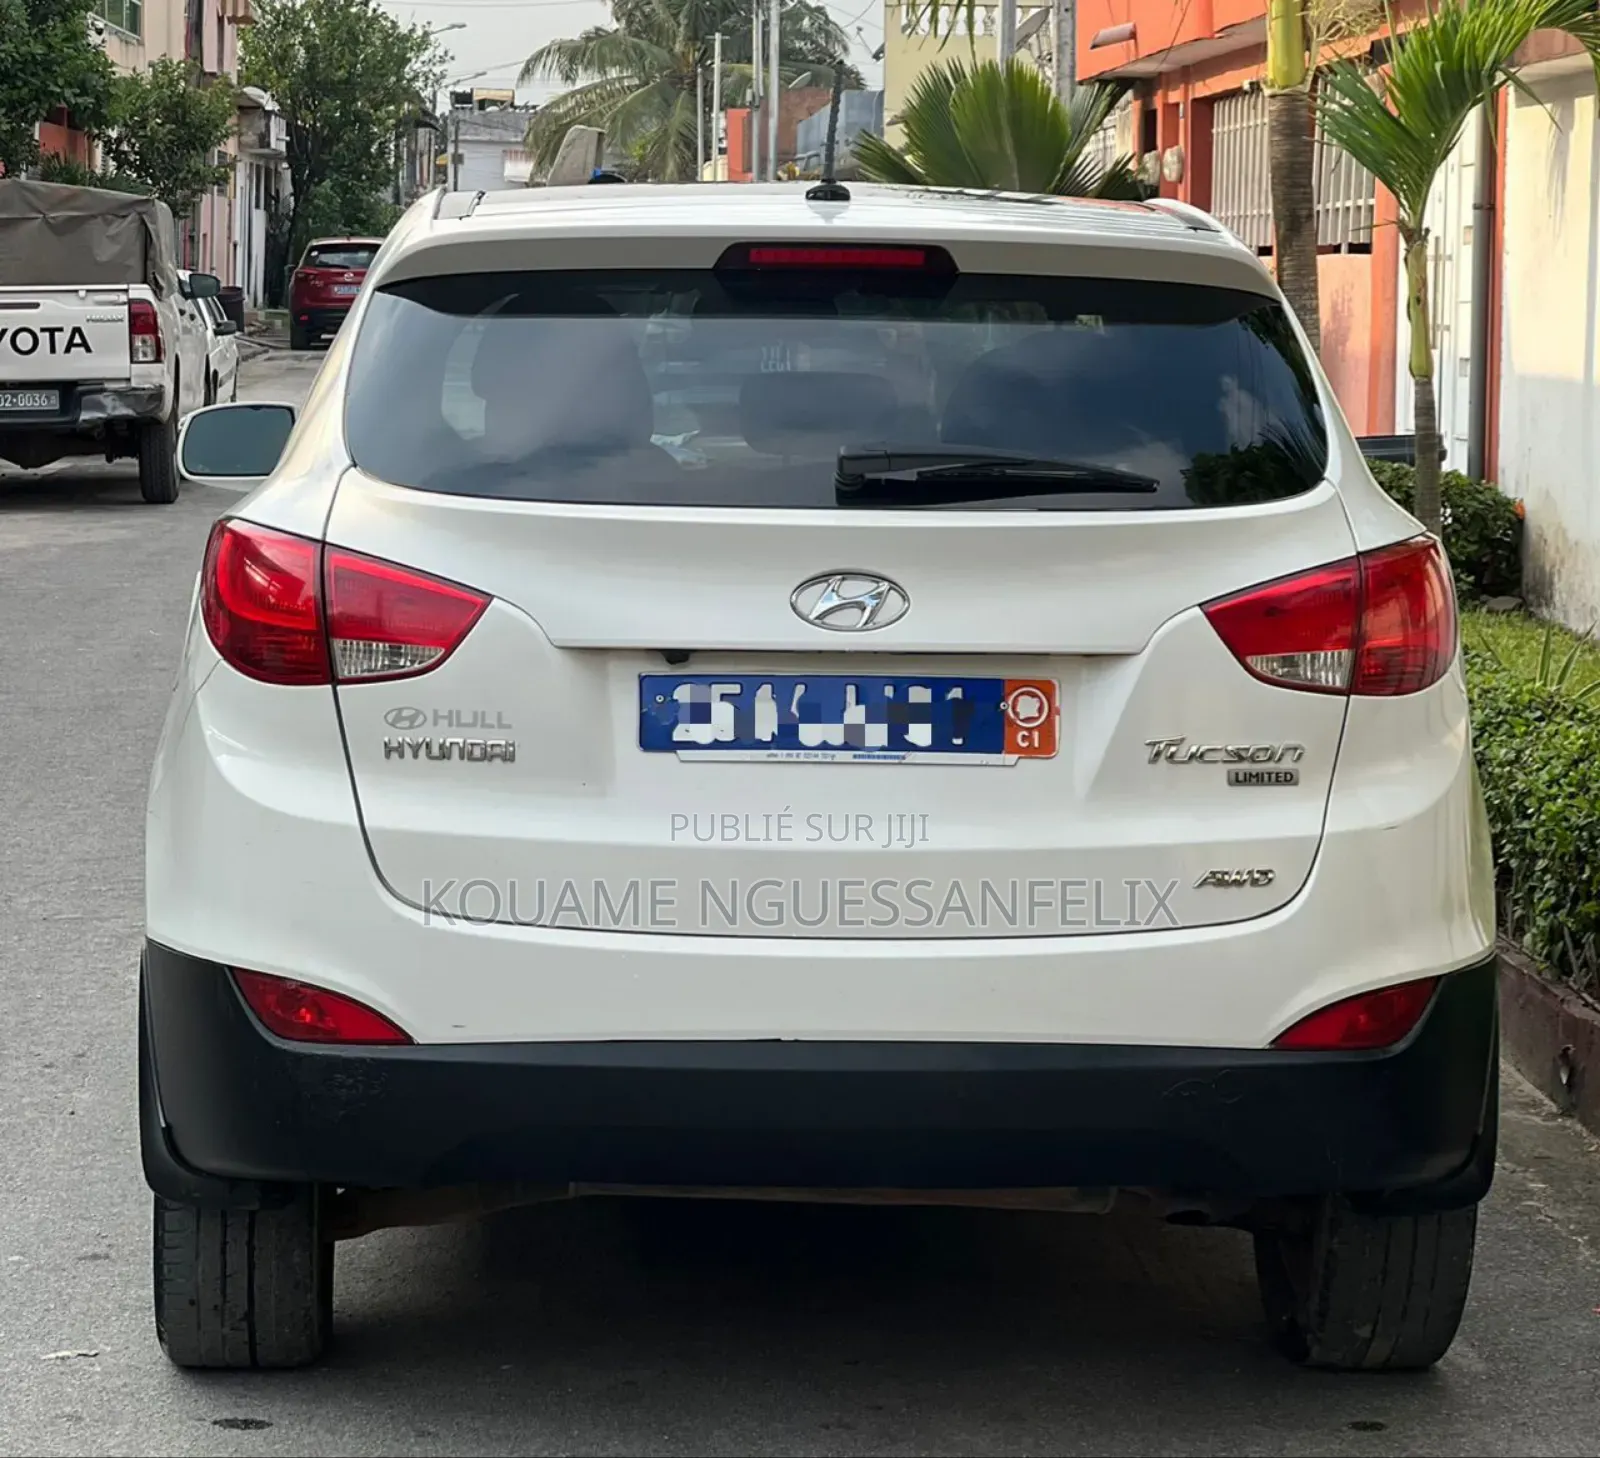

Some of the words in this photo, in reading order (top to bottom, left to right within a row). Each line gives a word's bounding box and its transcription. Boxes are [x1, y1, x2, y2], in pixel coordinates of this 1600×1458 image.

[432, 708, 513, 730] HULL
[383, 736, 516, 763] HYUNDAI
[1016, 731, 1040, 749] CI
[1234, 771, 1294, 784] LIMITED
[1192, 868, 1276, 889] AWD
